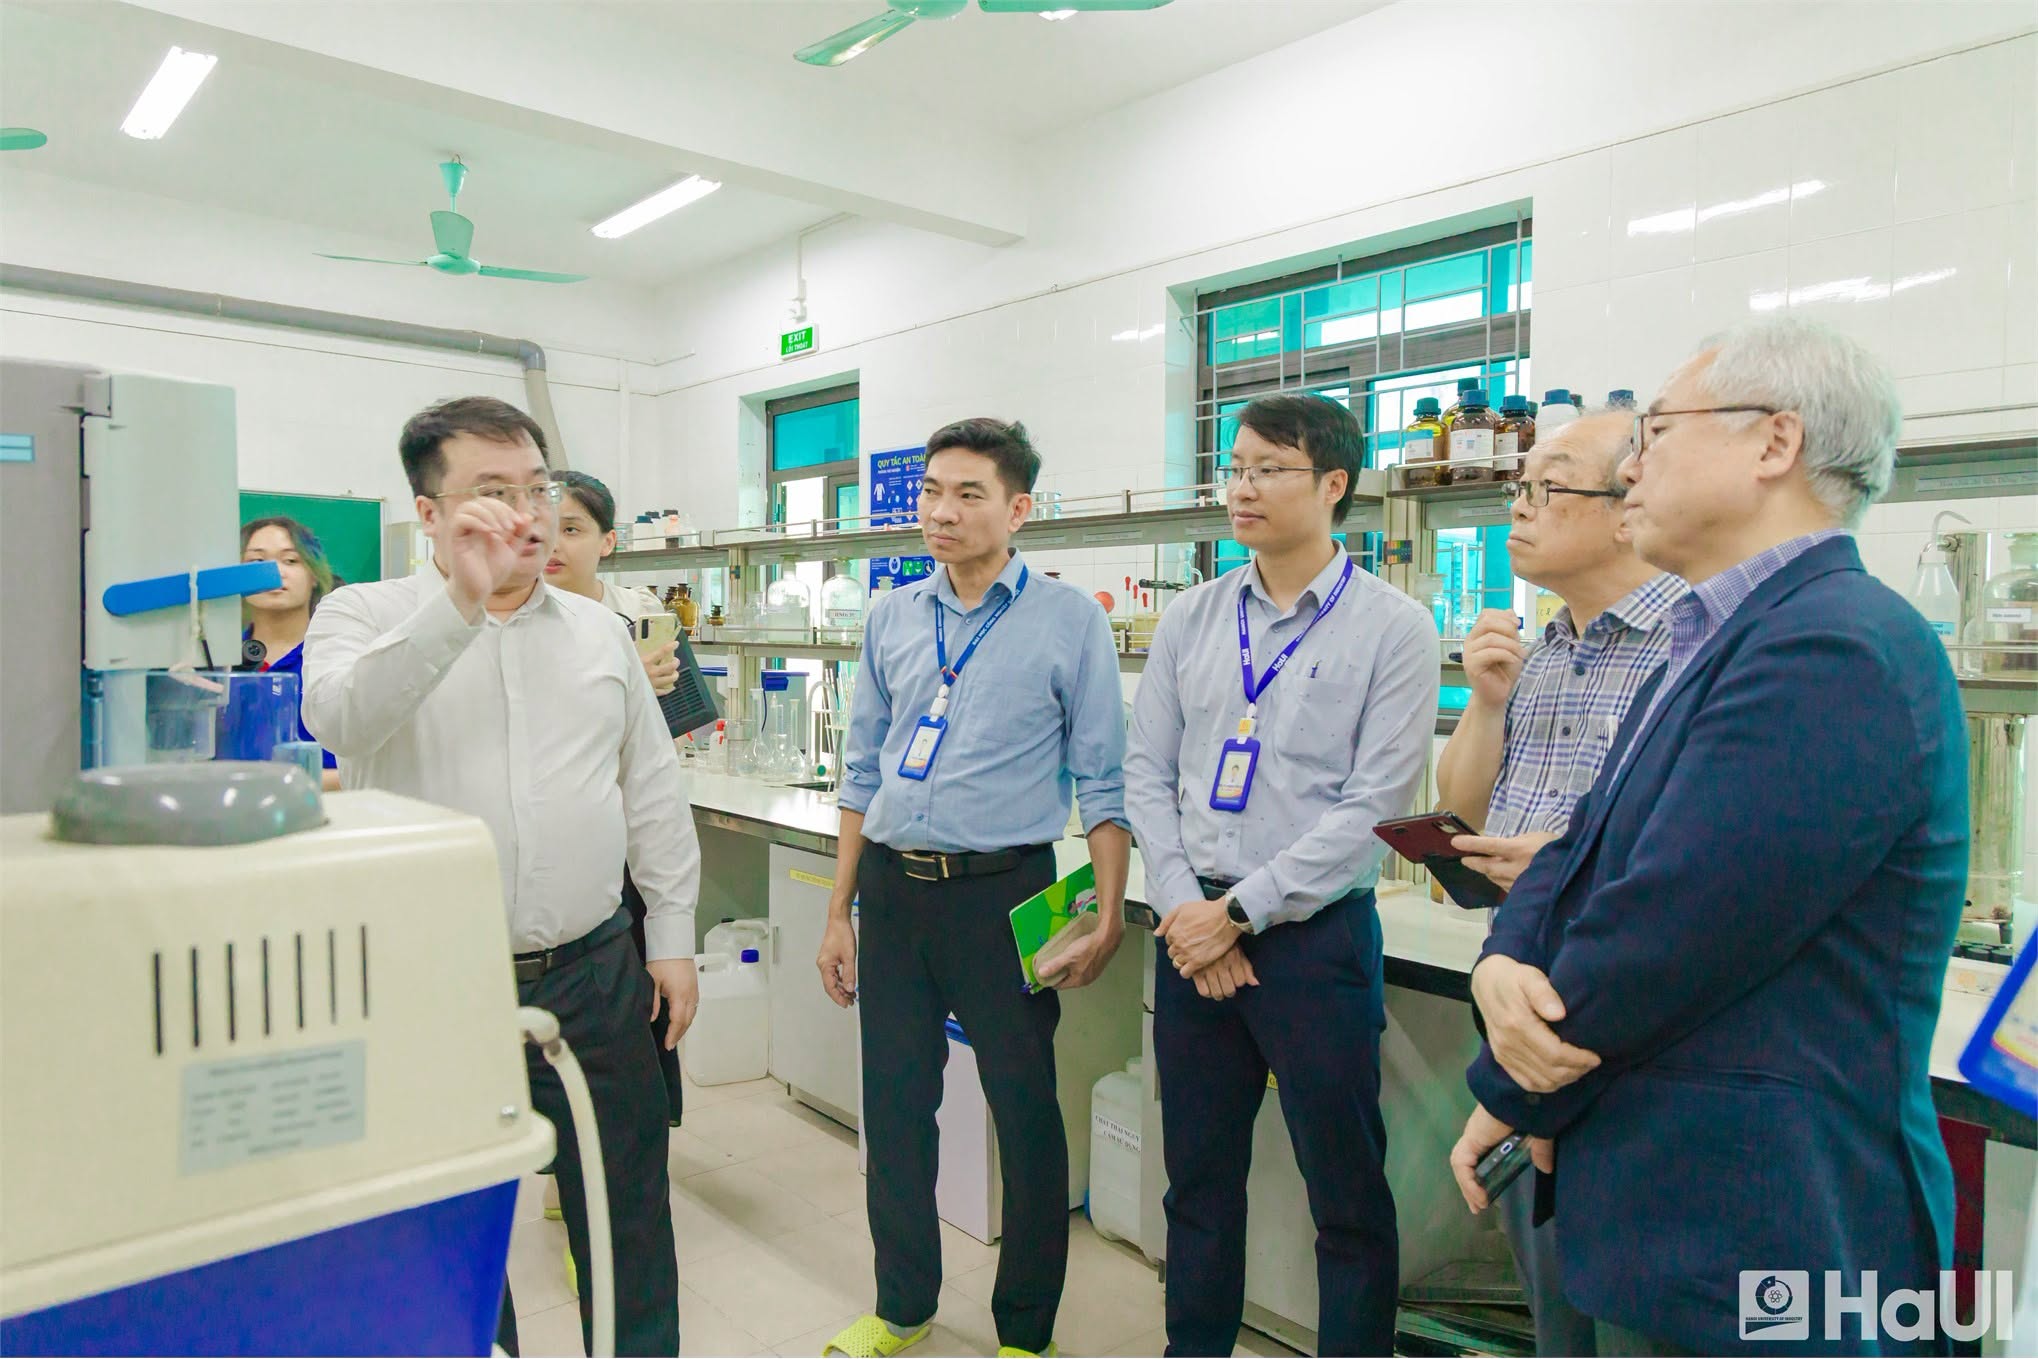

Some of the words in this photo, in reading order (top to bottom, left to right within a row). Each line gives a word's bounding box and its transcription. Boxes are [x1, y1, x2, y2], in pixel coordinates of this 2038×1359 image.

[788, 331, 807, 343] EXIT
[902, 456, 911, 465] AN
[1241, 647, 1251, 666] HaUI
[1272, 653, 1289, 672] HaUI
